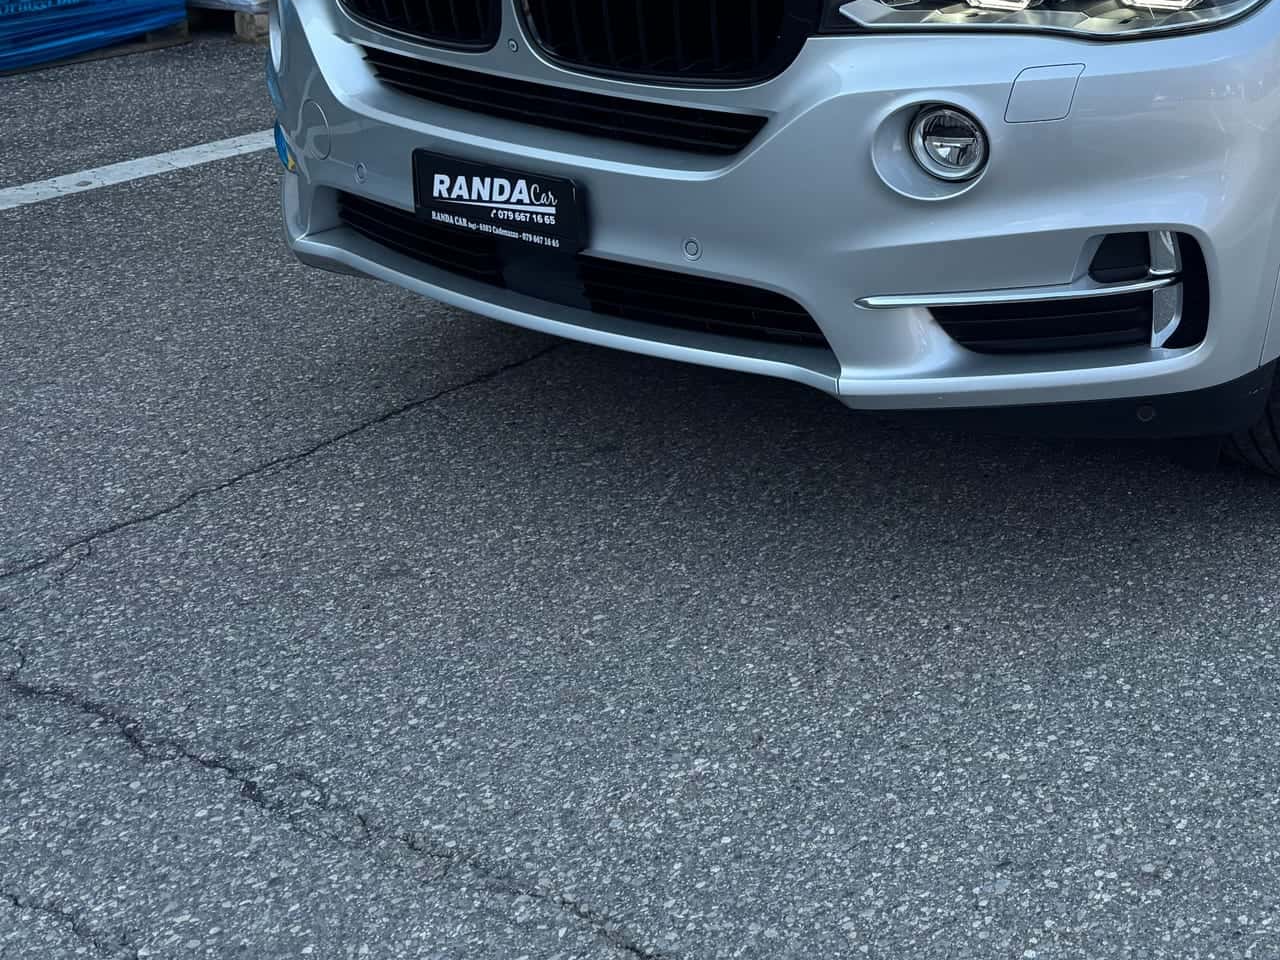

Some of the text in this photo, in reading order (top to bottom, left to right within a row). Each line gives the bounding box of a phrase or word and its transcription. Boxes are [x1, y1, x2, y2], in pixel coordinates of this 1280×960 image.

[432, 173, 558, 206] RANDA Car
[432, 210, 454, 224] RANDA
[454, 215, 468, 227] CAR
[498, 209, 556, 225] 079 667 16 65
